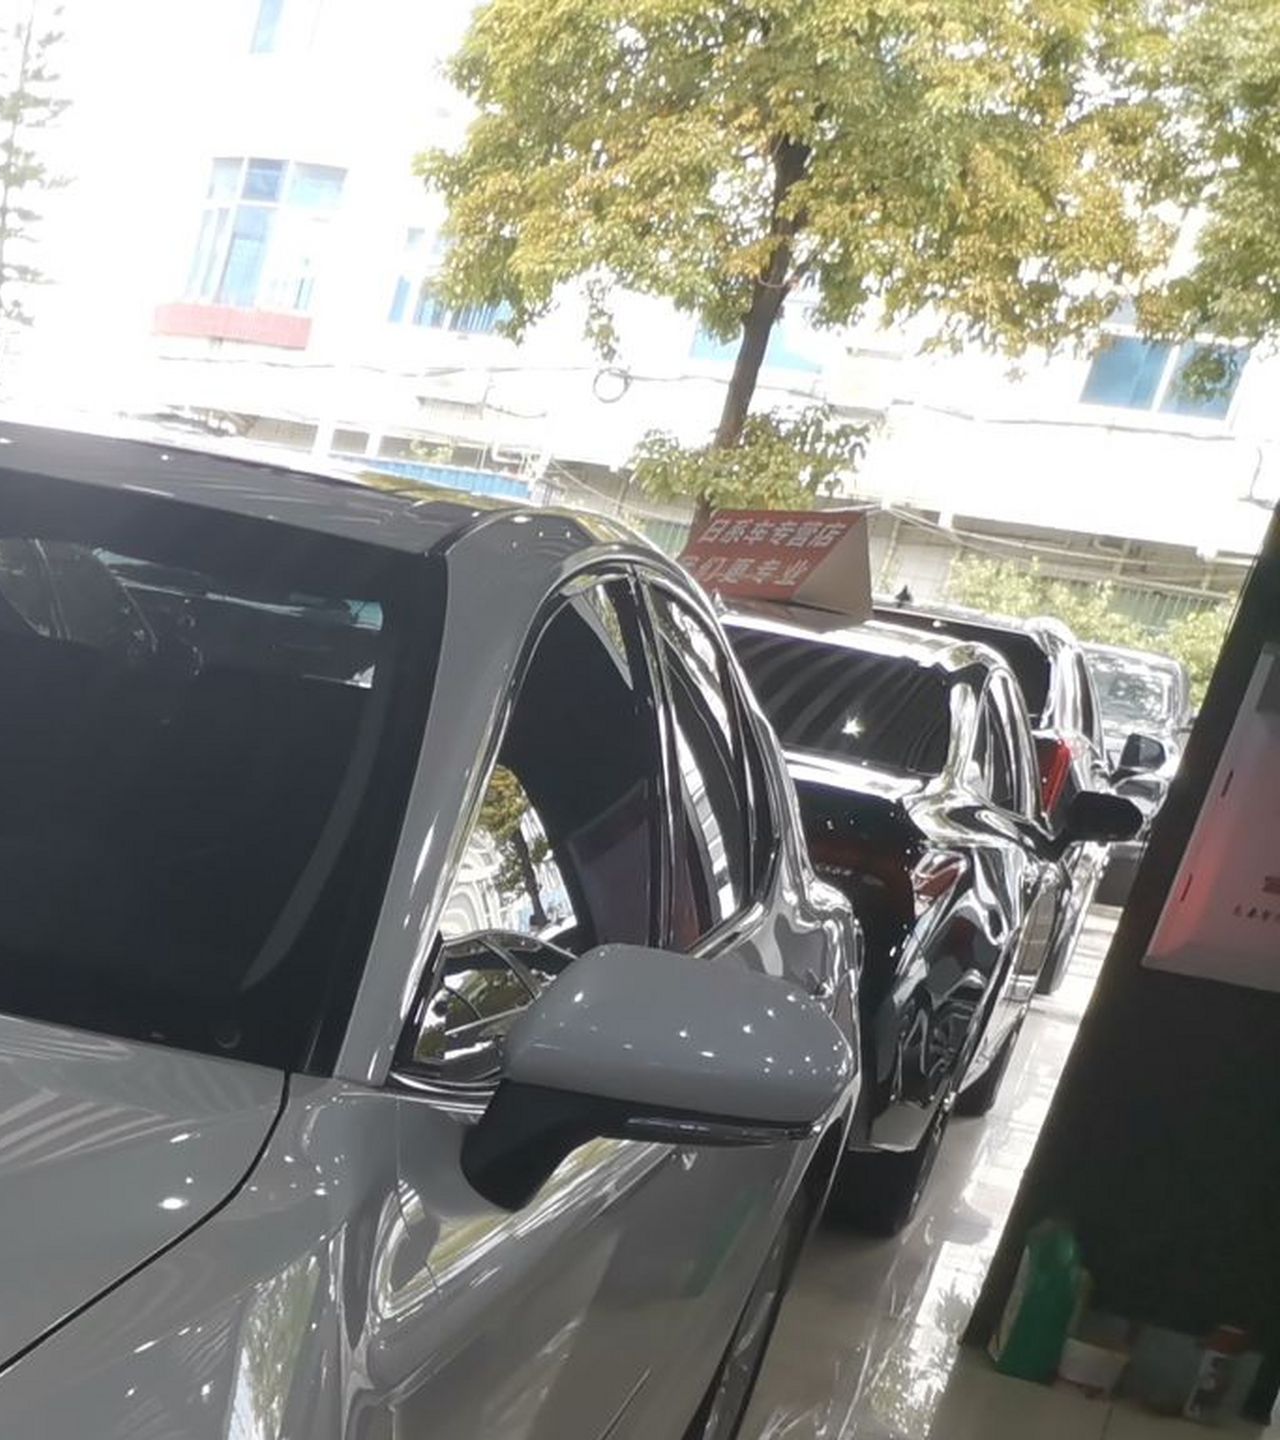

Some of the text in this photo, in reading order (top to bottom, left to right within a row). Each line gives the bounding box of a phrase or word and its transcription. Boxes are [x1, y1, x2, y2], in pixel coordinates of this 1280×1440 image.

[697, 518, 847, 548] 日系车专营店
